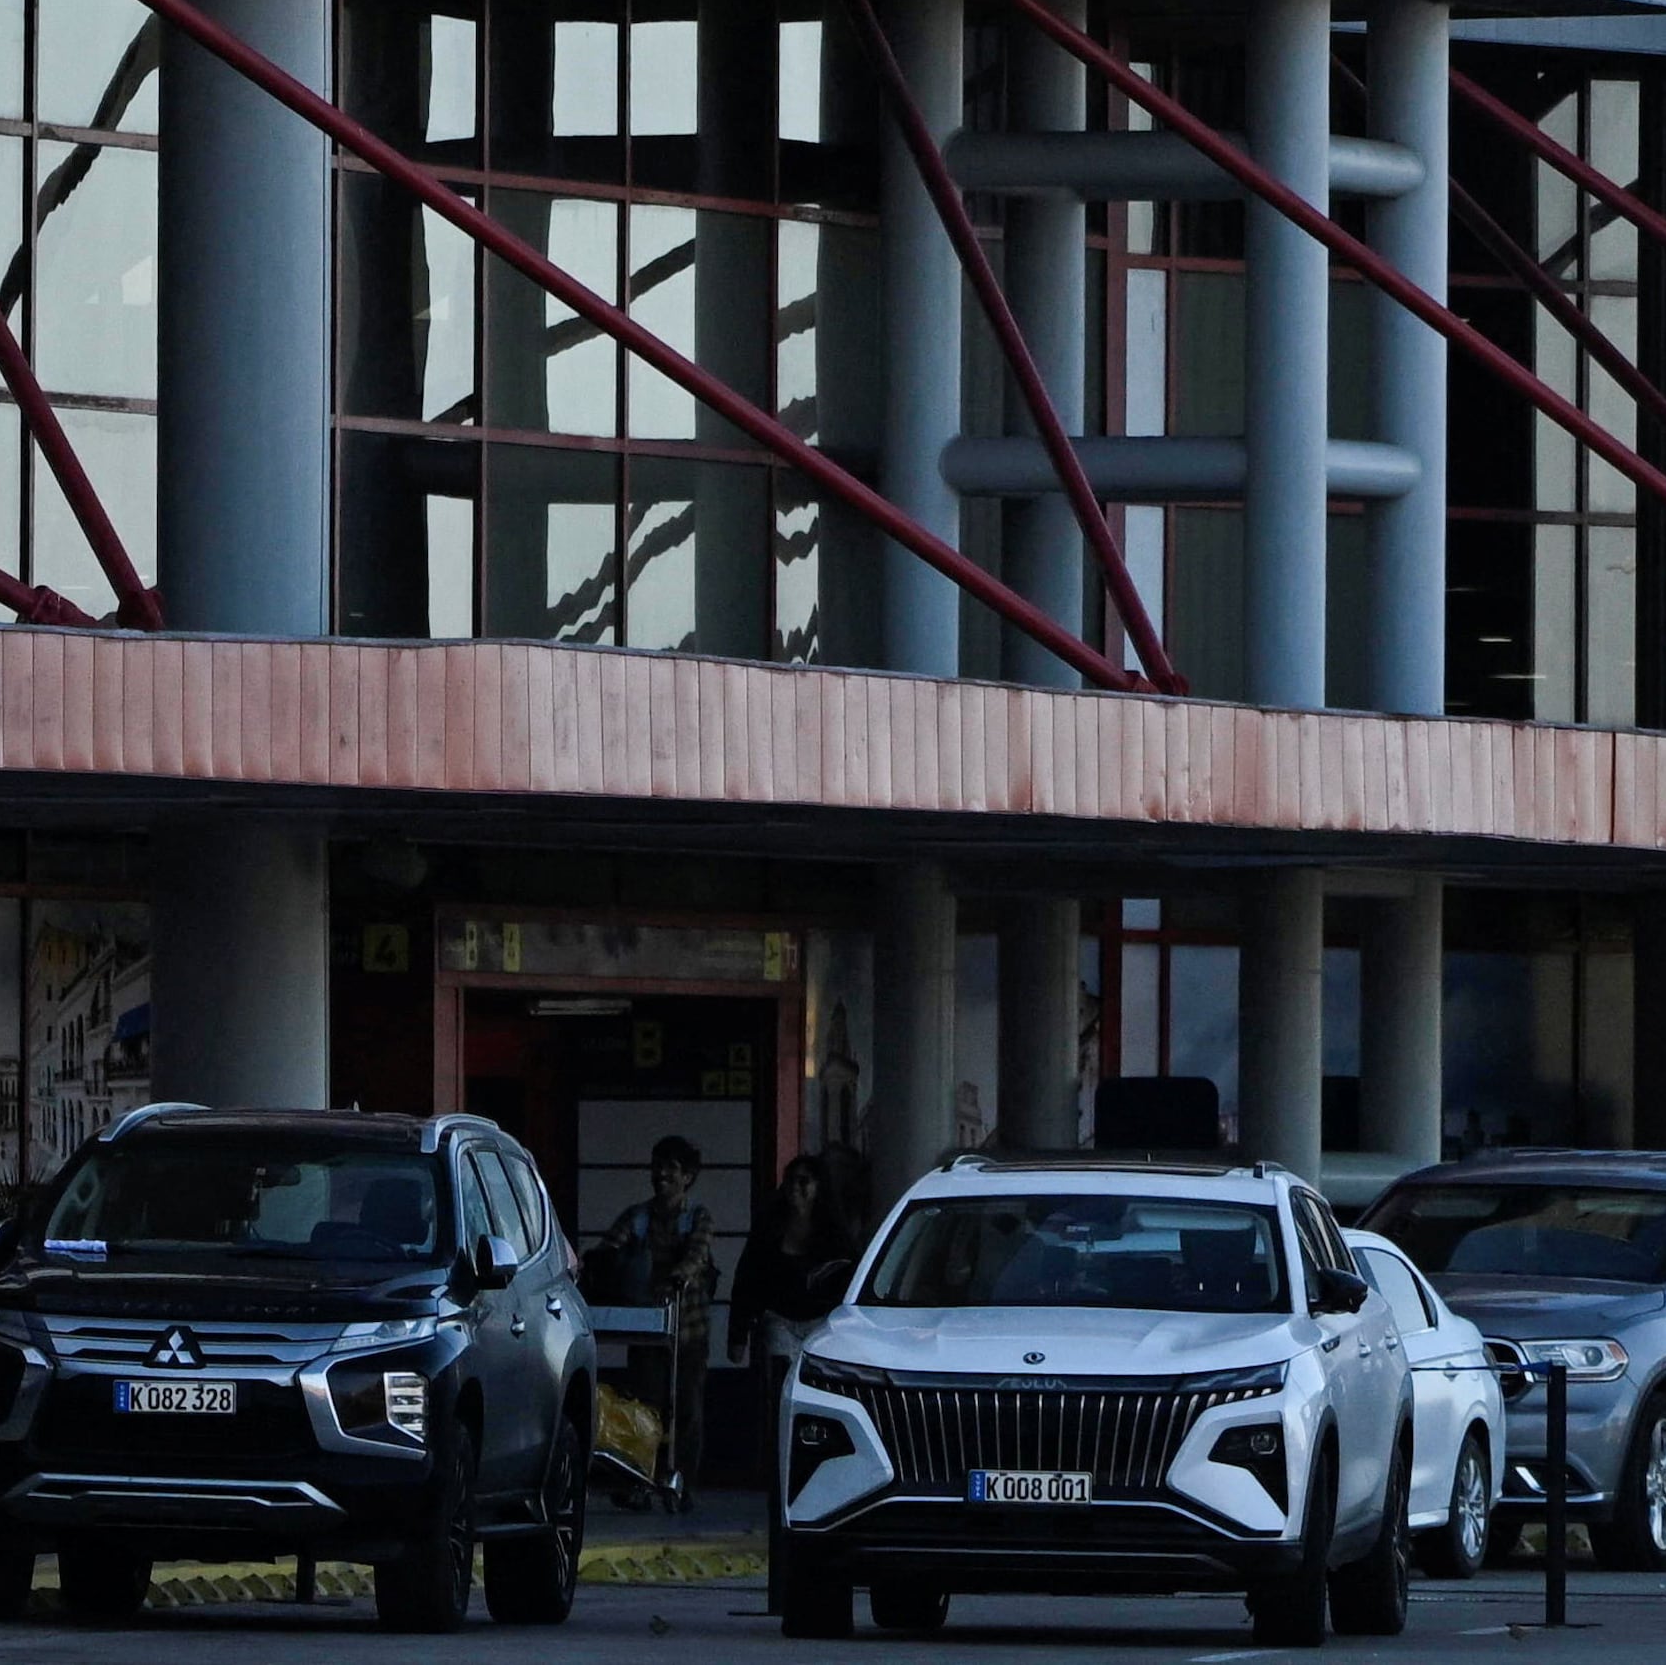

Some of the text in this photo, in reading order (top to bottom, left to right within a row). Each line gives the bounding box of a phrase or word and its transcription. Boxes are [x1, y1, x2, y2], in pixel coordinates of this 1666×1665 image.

[130, 1386, 143, 1410] K
[148, 1387, 188, 1410] 082
[192, 1388, 231, 1411] 328
[986, 1476, 999, 1499] K
[1003, 1477, 1043, 1500] 008
[1048, 1478, 1087, 1501] 001
